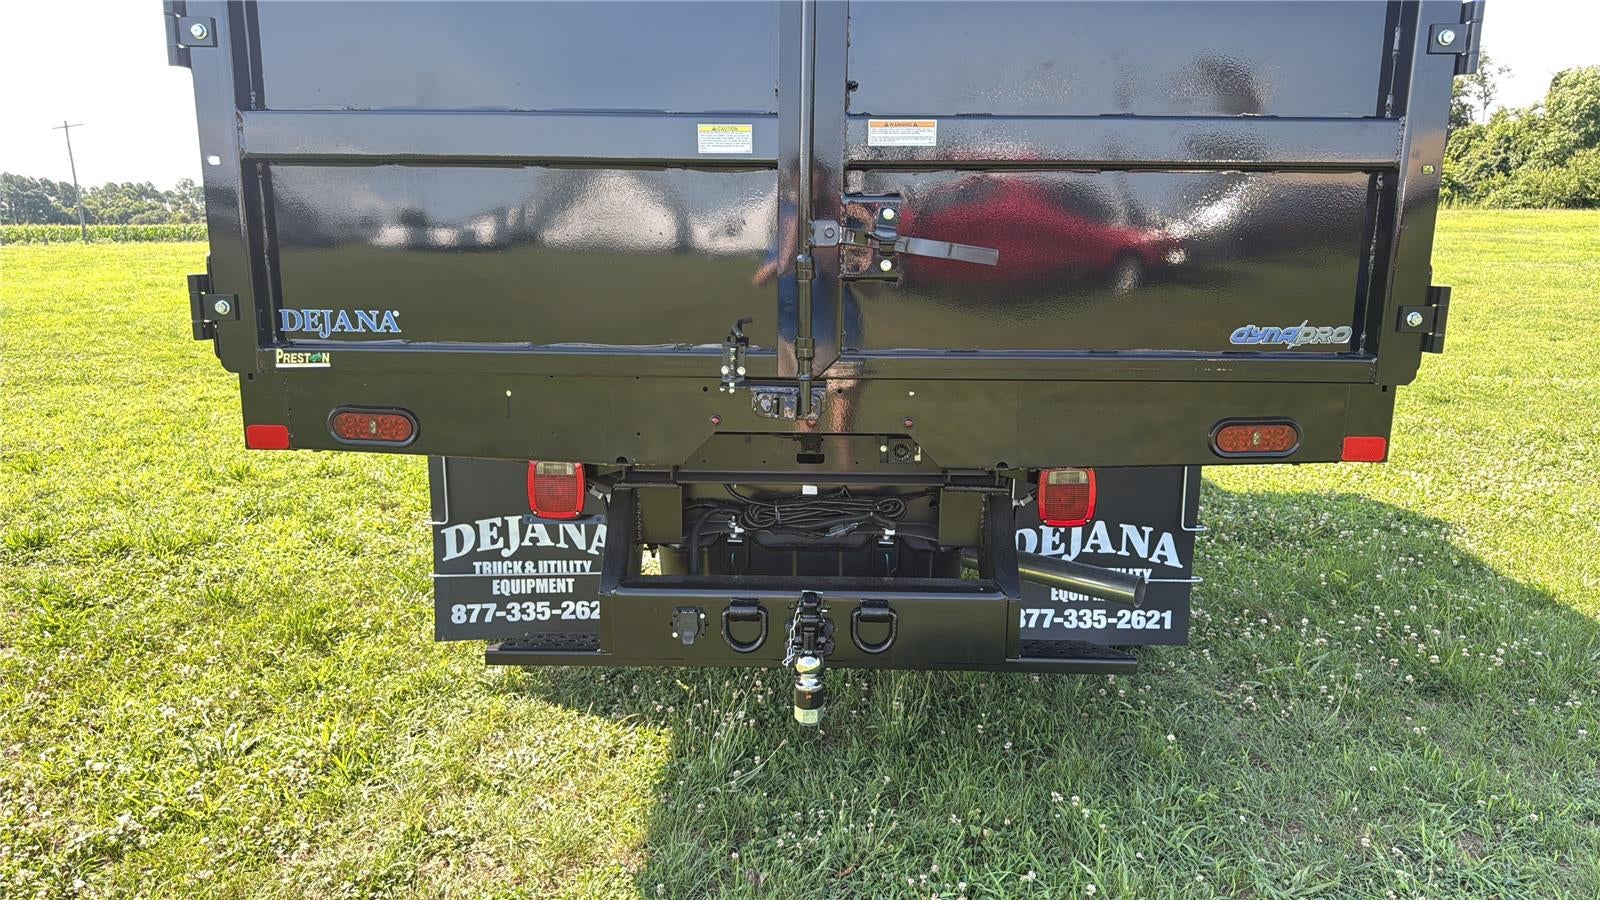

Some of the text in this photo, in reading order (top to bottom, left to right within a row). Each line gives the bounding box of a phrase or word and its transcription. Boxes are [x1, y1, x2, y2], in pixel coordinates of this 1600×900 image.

[440, 514, 607, 562] DEJANA
[1015, 520, 1183, 568] DEJANA
[492, 578, 575, 596] EQUIPMENT
[451, 601, 600, 624] 877-335-262
